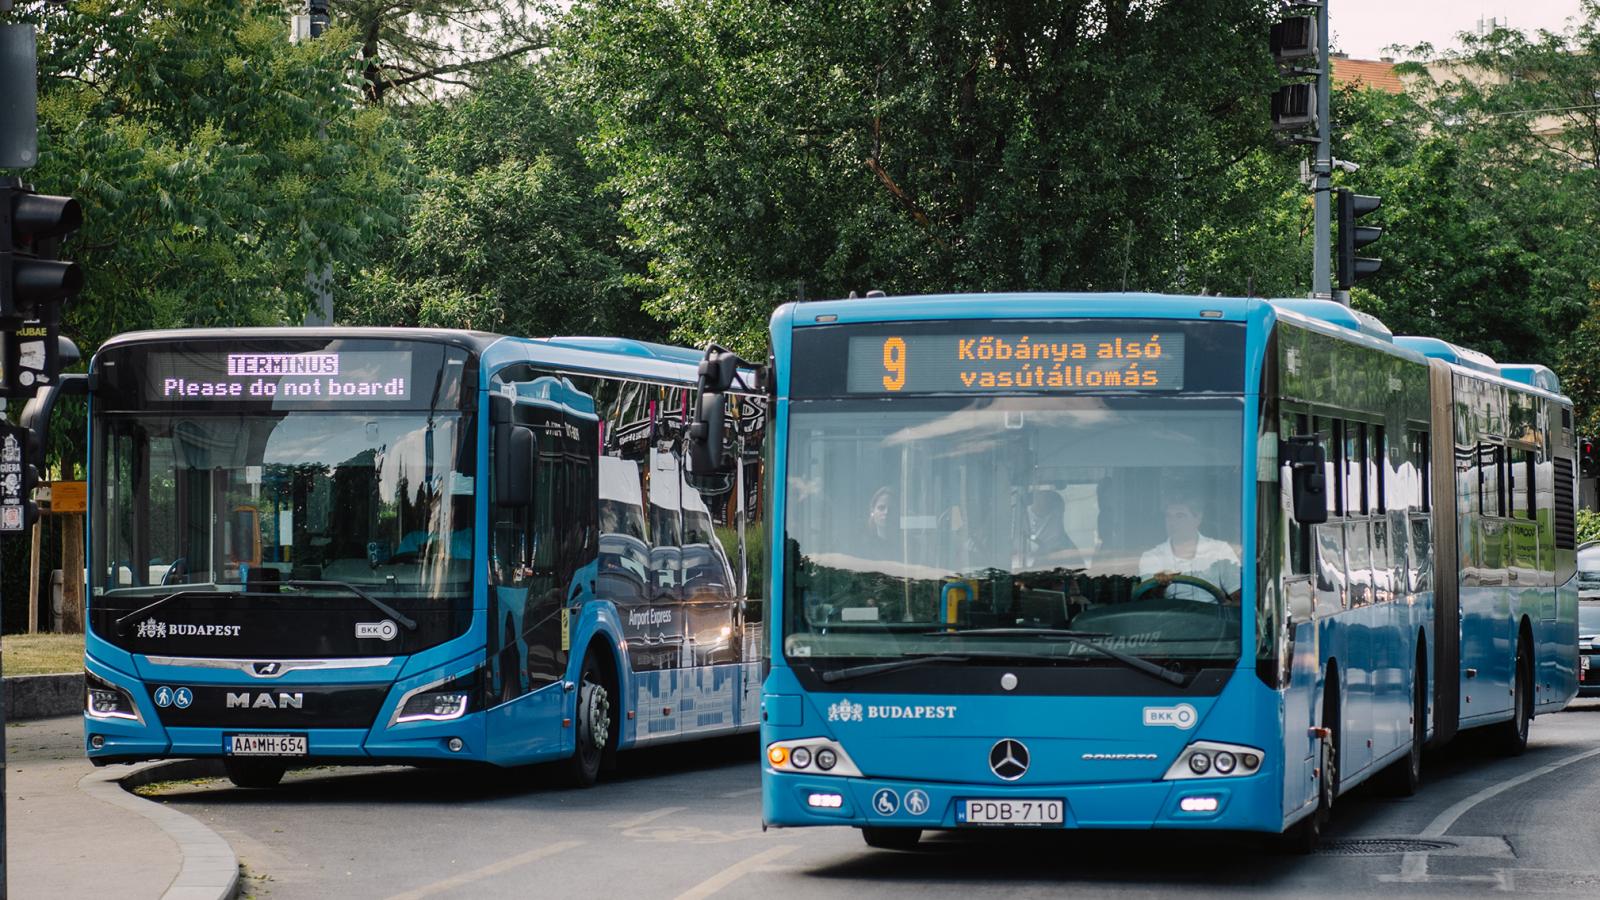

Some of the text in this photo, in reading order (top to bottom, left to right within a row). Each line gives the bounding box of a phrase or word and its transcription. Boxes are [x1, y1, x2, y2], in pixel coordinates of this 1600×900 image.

[958, 335, 1162, 362] Kőbánya alsó
[231, 356, 337, 374] TERMINUS
[883, 337, 906, 391] 9
[960, 363, 1159, 387] vasútállomás
[164, 378, 405, 396] Please do not board!
[628, 608, 672, 629] Airport Express
[169, 624, 241, 637] BUDAPEST
[226, 692, 303, 709] MAN
[867, 706, 957, 719] BUDAPEST
[1150, 712, 1173, 721] BKK
[971, 803, 1058, 820] PDB-710
